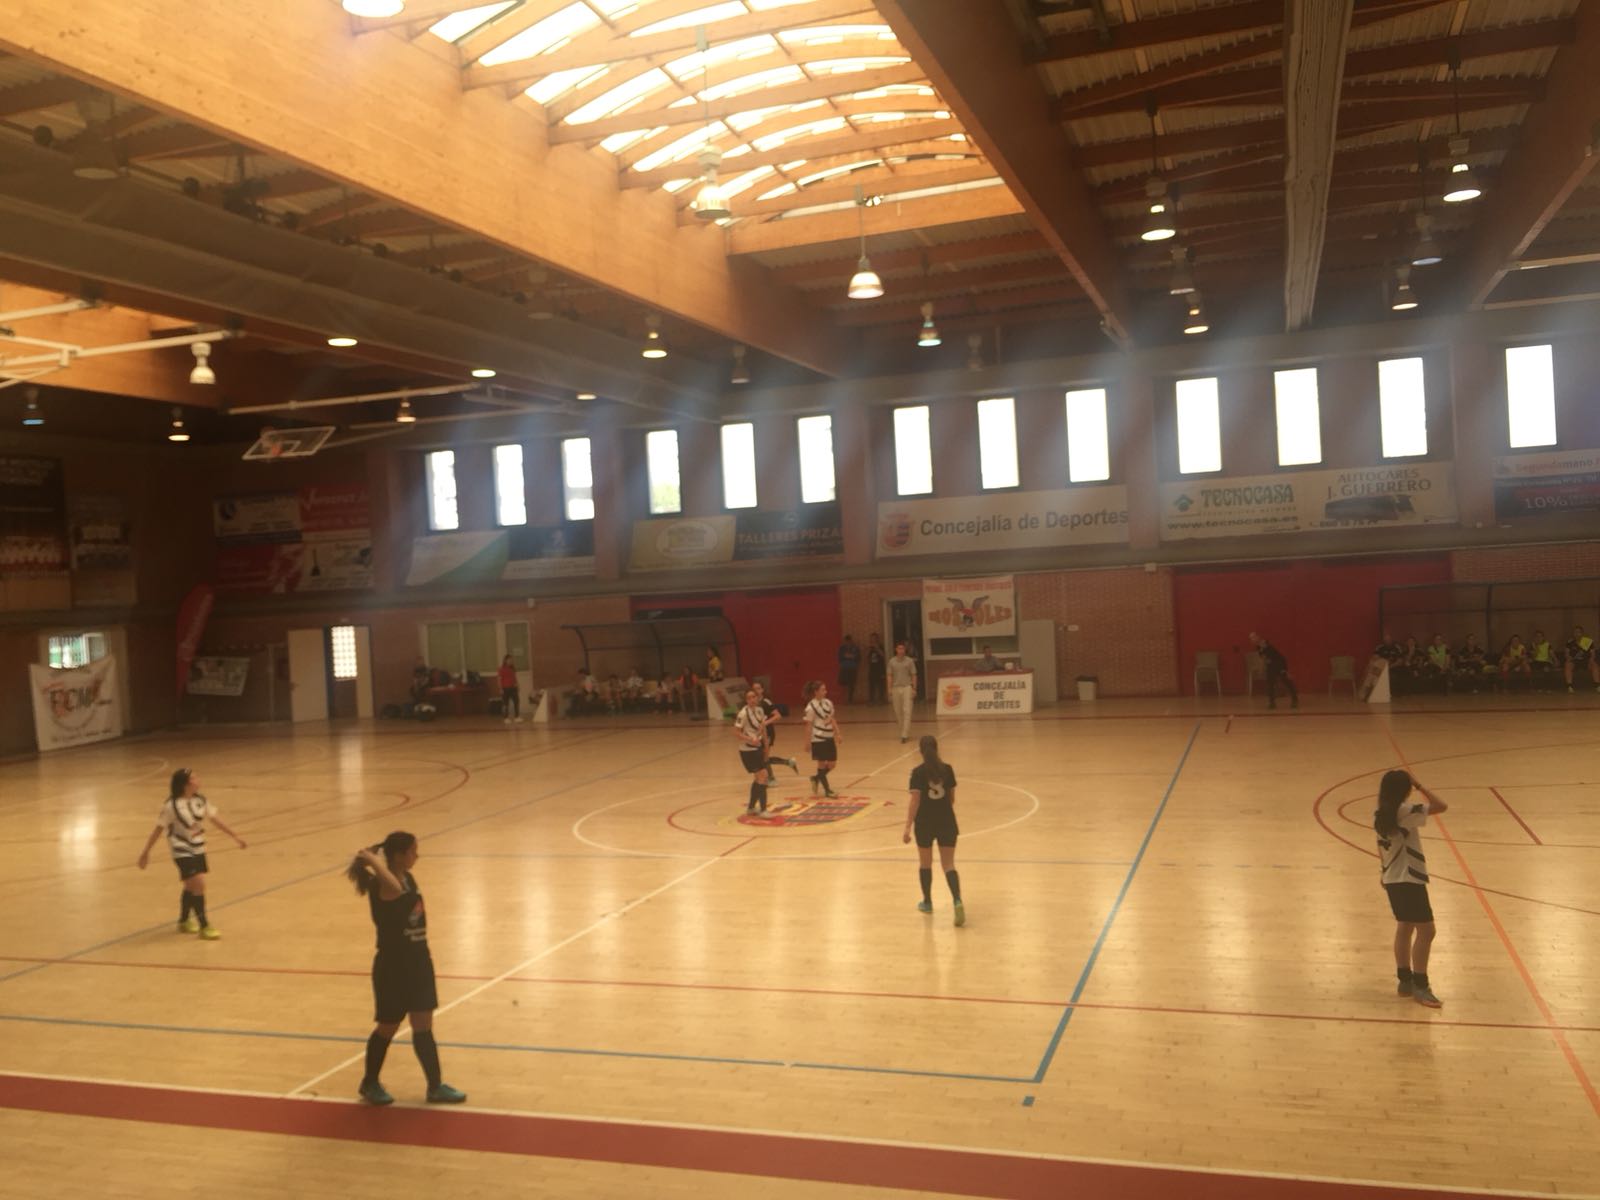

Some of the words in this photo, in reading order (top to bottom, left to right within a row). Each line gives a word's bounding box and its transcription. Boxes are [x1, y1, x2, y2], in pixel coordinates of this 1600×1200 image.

[1338, 468, 1420, 483] AUTOCARES
[1201, 484, 1294, 508] TECNOCASA
[1340, 479, 1432, 497] GUERRERO
[1018, 513, 1040, 530] de
[1045, 509, 1129, 529] Deportes
[993, 691, 1005, 699] DE
[976, 700, 1021, 710] DEPORTES
